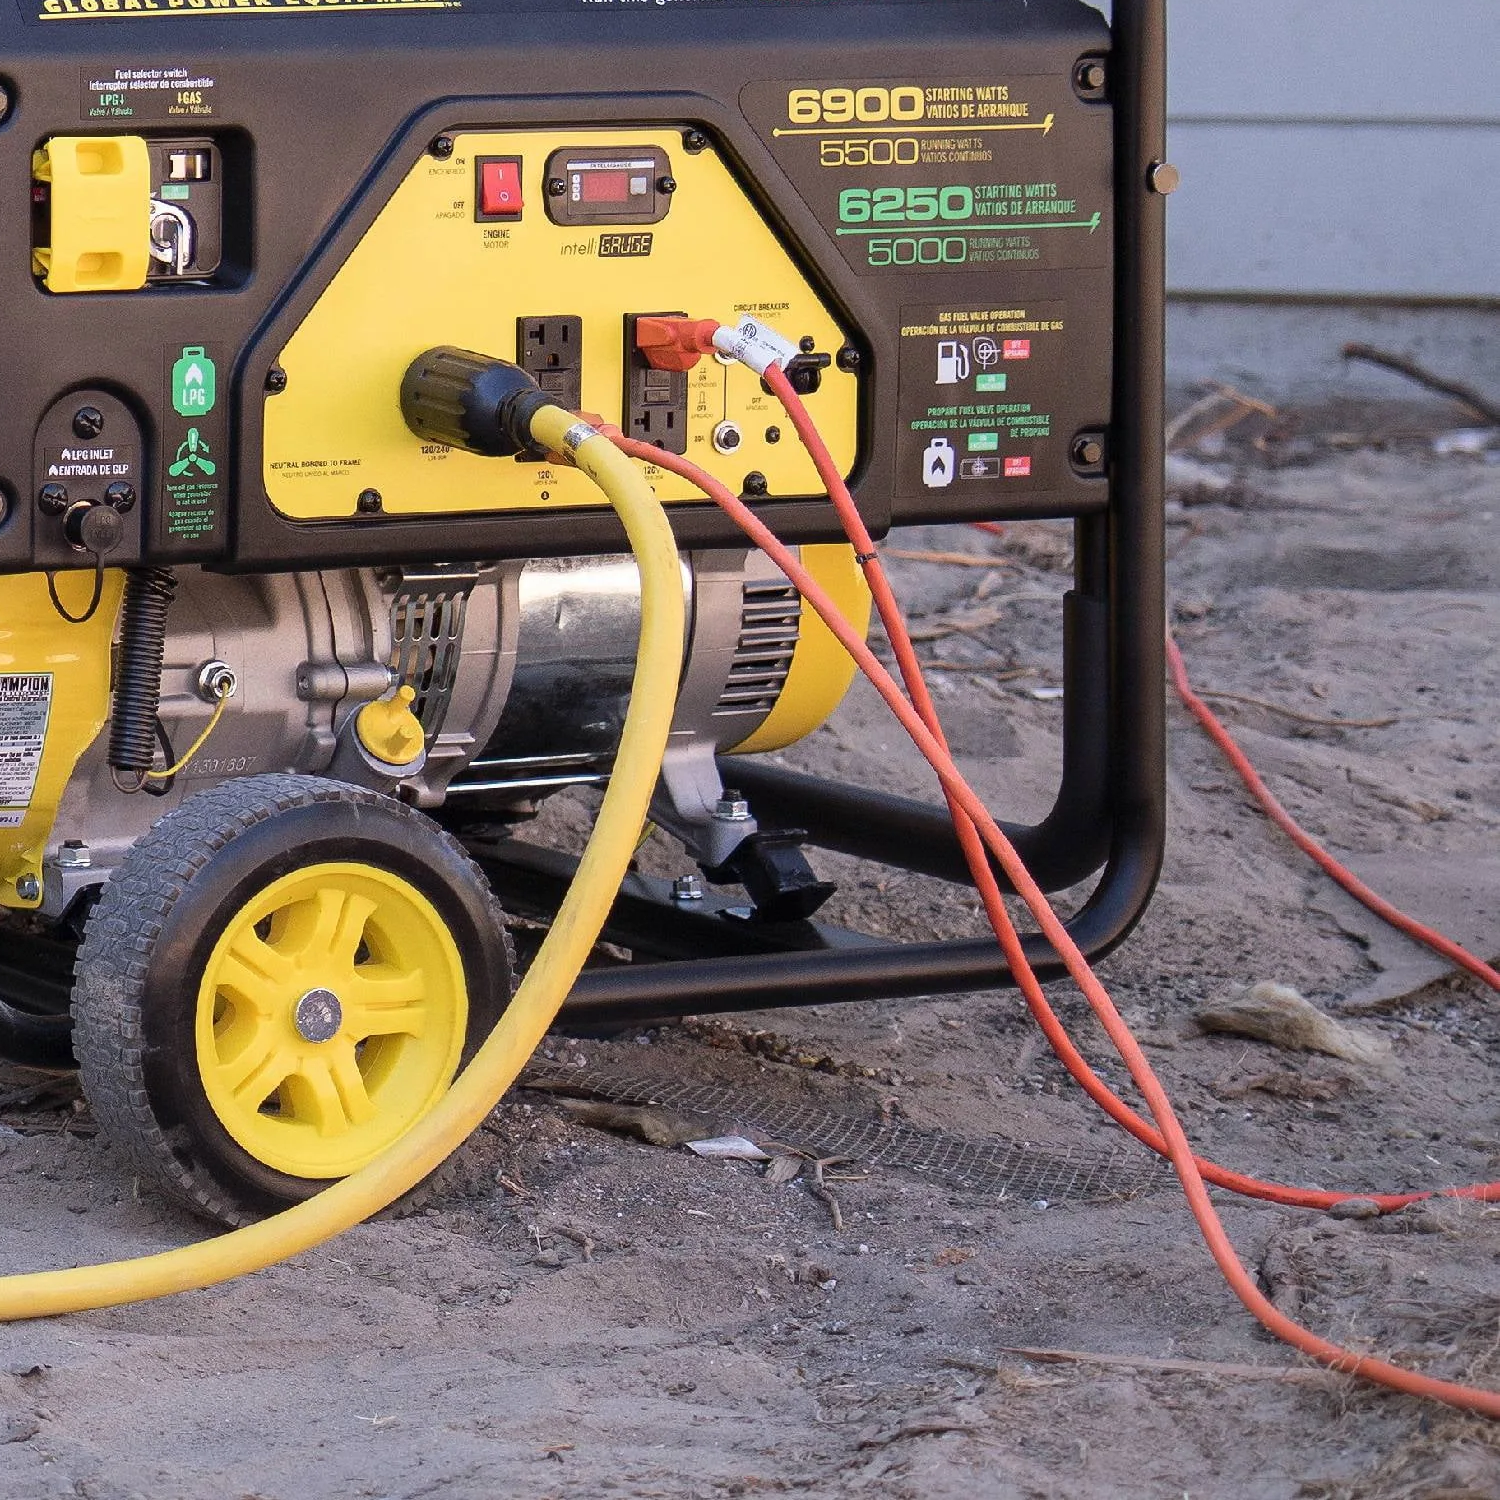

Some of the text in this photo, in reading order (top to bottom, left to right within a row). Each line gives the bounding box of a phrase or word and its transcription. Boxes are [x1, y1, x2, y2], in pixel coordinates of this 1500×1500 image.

[99, 93, 118, 107] LPG
[182, 91, 203, 105] GAS
[925, 86, 1009, 102] STARTING WATTS
[788, 86, 924, 124] 6900
[925, 102, 1029, 119] VATIOS DE ARRANQUE
[956, 137, 983, 150] WATTS
[820, 137, 920, 167] 5500
[920, 151, 948, 163] VATIOS
[974, 183, 1057, 200] STARTING WATTS
[453, 201, 465, 210] OFF
[838, 185, 974, 223] 6250
[975, 199, 1077, 217] VATIOS DE ARRANQUE
[483, 229, 511, 239] ENGINE
[483, 240, 510, 249] MOTOR
[867, 236, 967, 267] 5000
[733, 302, 790, 313] CIRCUIT BREAKERS
[182, 388, 206, 406] LPG
[71, 449, 114, 461] LPG INLET
[59, 464, 129, 476] ENTRADA DE GLP
